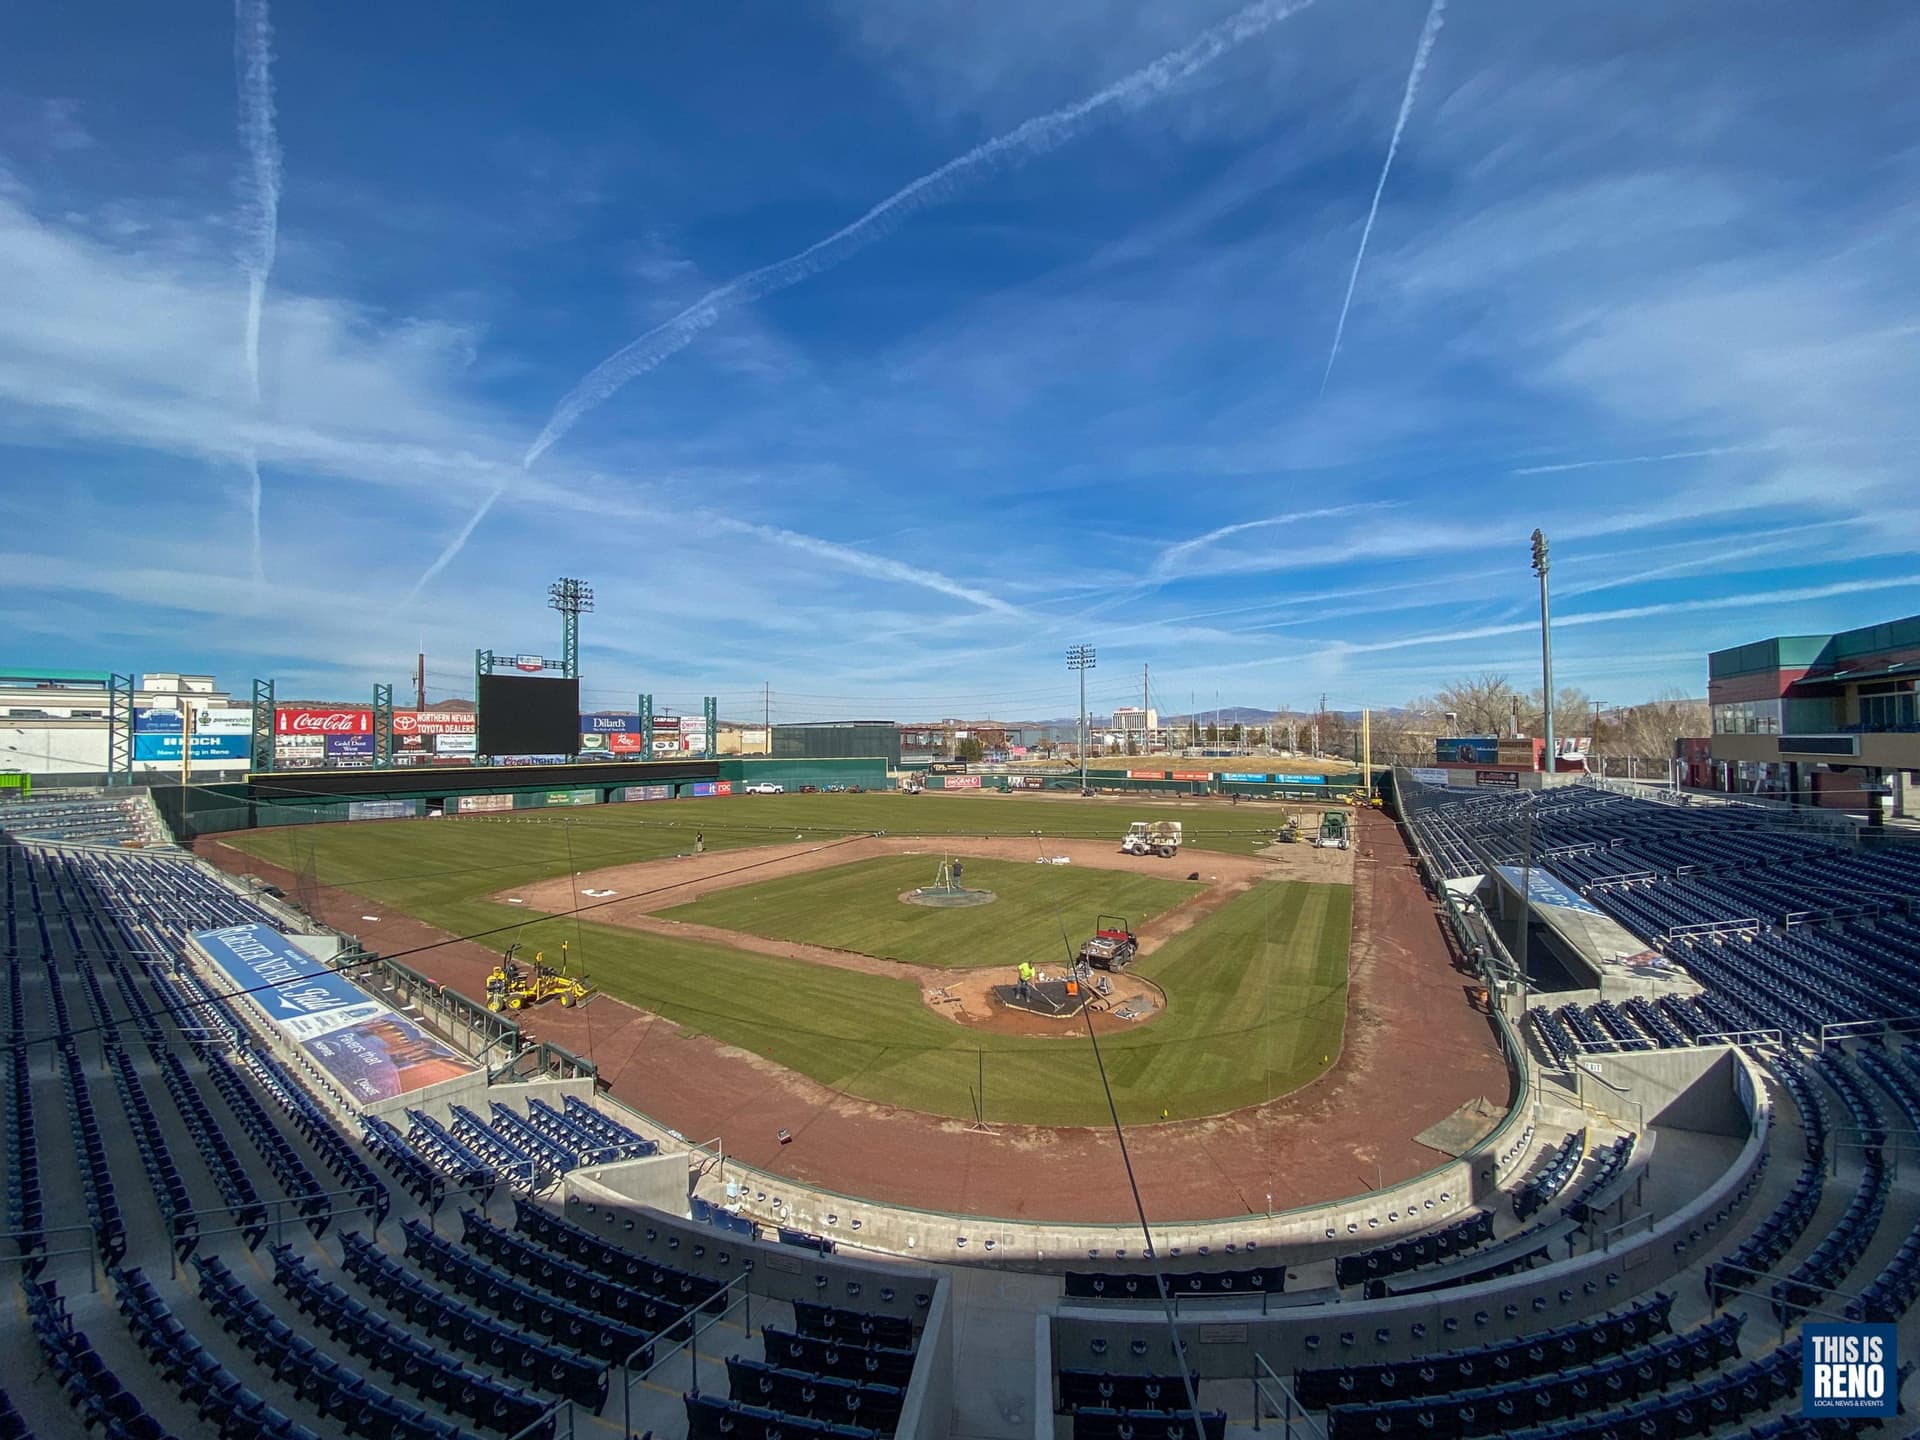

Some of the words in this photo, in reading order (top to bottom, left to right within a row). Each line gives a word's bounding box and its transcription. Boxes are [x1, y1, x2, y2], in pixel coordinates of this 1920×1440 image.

[417, 713, 450, 722] NORTHERN
[452, 714, 475, 723] NEVADA
[593, 718, 626, 727] Dillard's
[417, 725, 444, 733] TOYOTA
[445, 725, 475, 733] DEALERS
[217, 930, 274, 965] GREATER
[247, 957, 313, 992] NEVADA
[282, 988, 349, 1010] Field
[337, 1032, 366, 1053] Pavers
[358, 1051, 383, 1065] that
